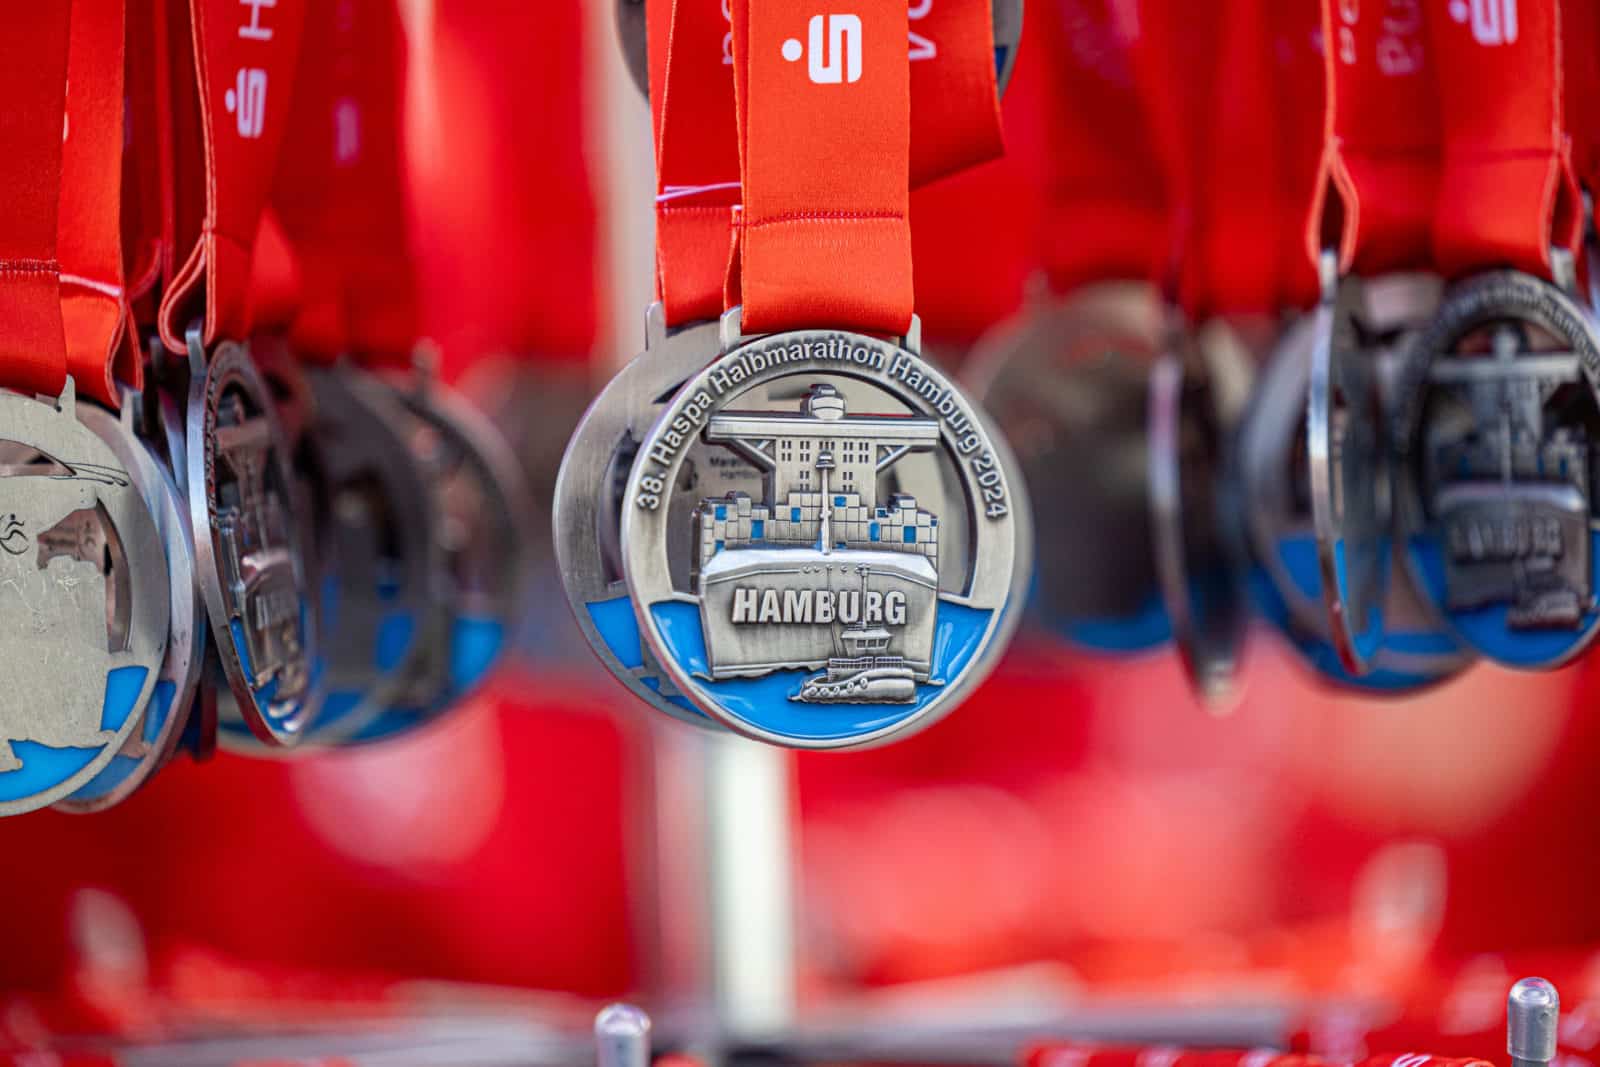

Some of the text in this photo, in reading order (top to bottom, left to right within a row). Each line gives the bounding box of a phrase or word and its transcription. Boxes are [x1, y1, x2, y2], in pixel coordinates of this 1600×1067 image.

[637, 337, 1008, 518] 38. Haspa Halbmarathon Hamburg 2024
[731, 588, 907, 625] HAMBURG
